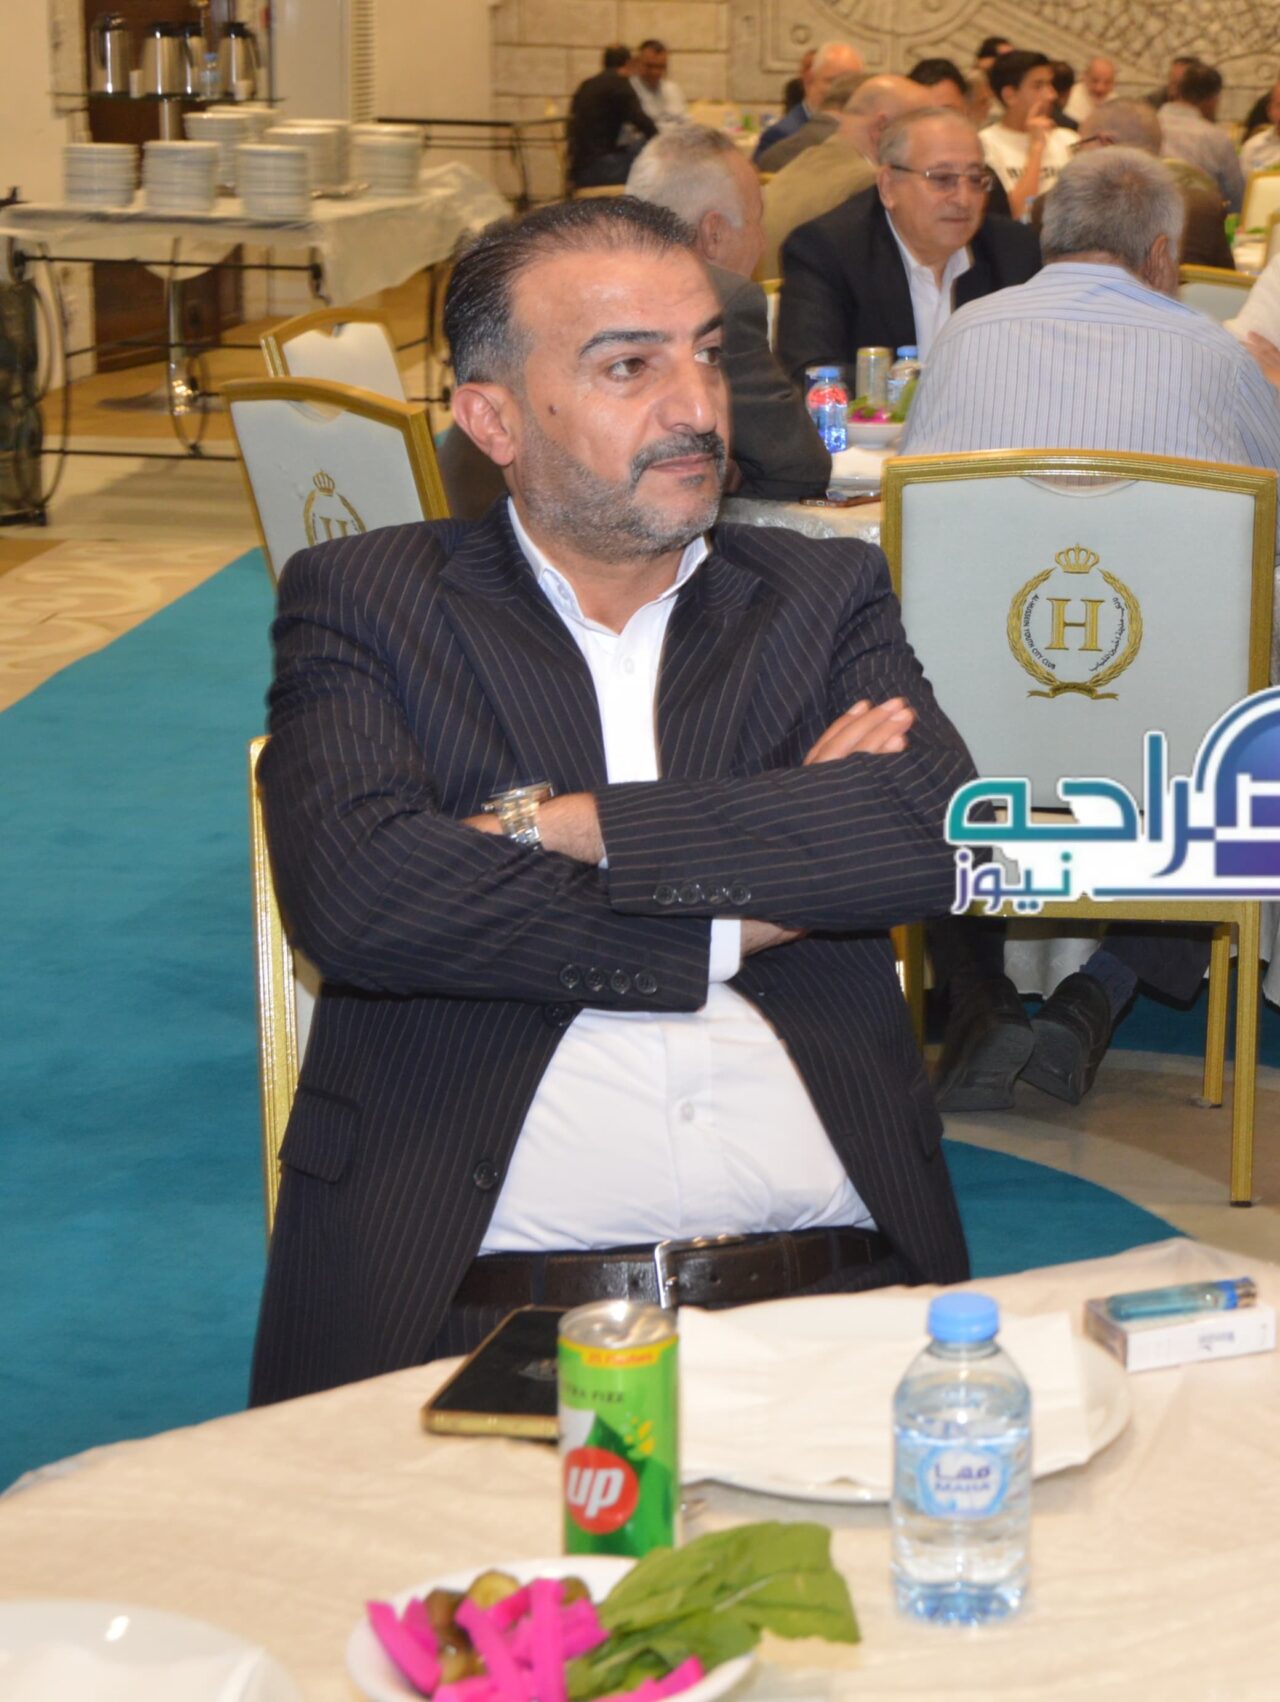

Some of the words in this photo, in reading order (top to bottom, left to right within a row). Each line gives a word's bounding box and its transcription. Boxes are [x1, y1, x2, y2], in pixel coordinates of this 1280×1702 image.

[1044, 598, 1105, 651] H
[1023, 629, 1035, 648] YOUTH
[1031, 648, 1043, 660] CITY
[1041, 658, 1056, 670] CLUB
